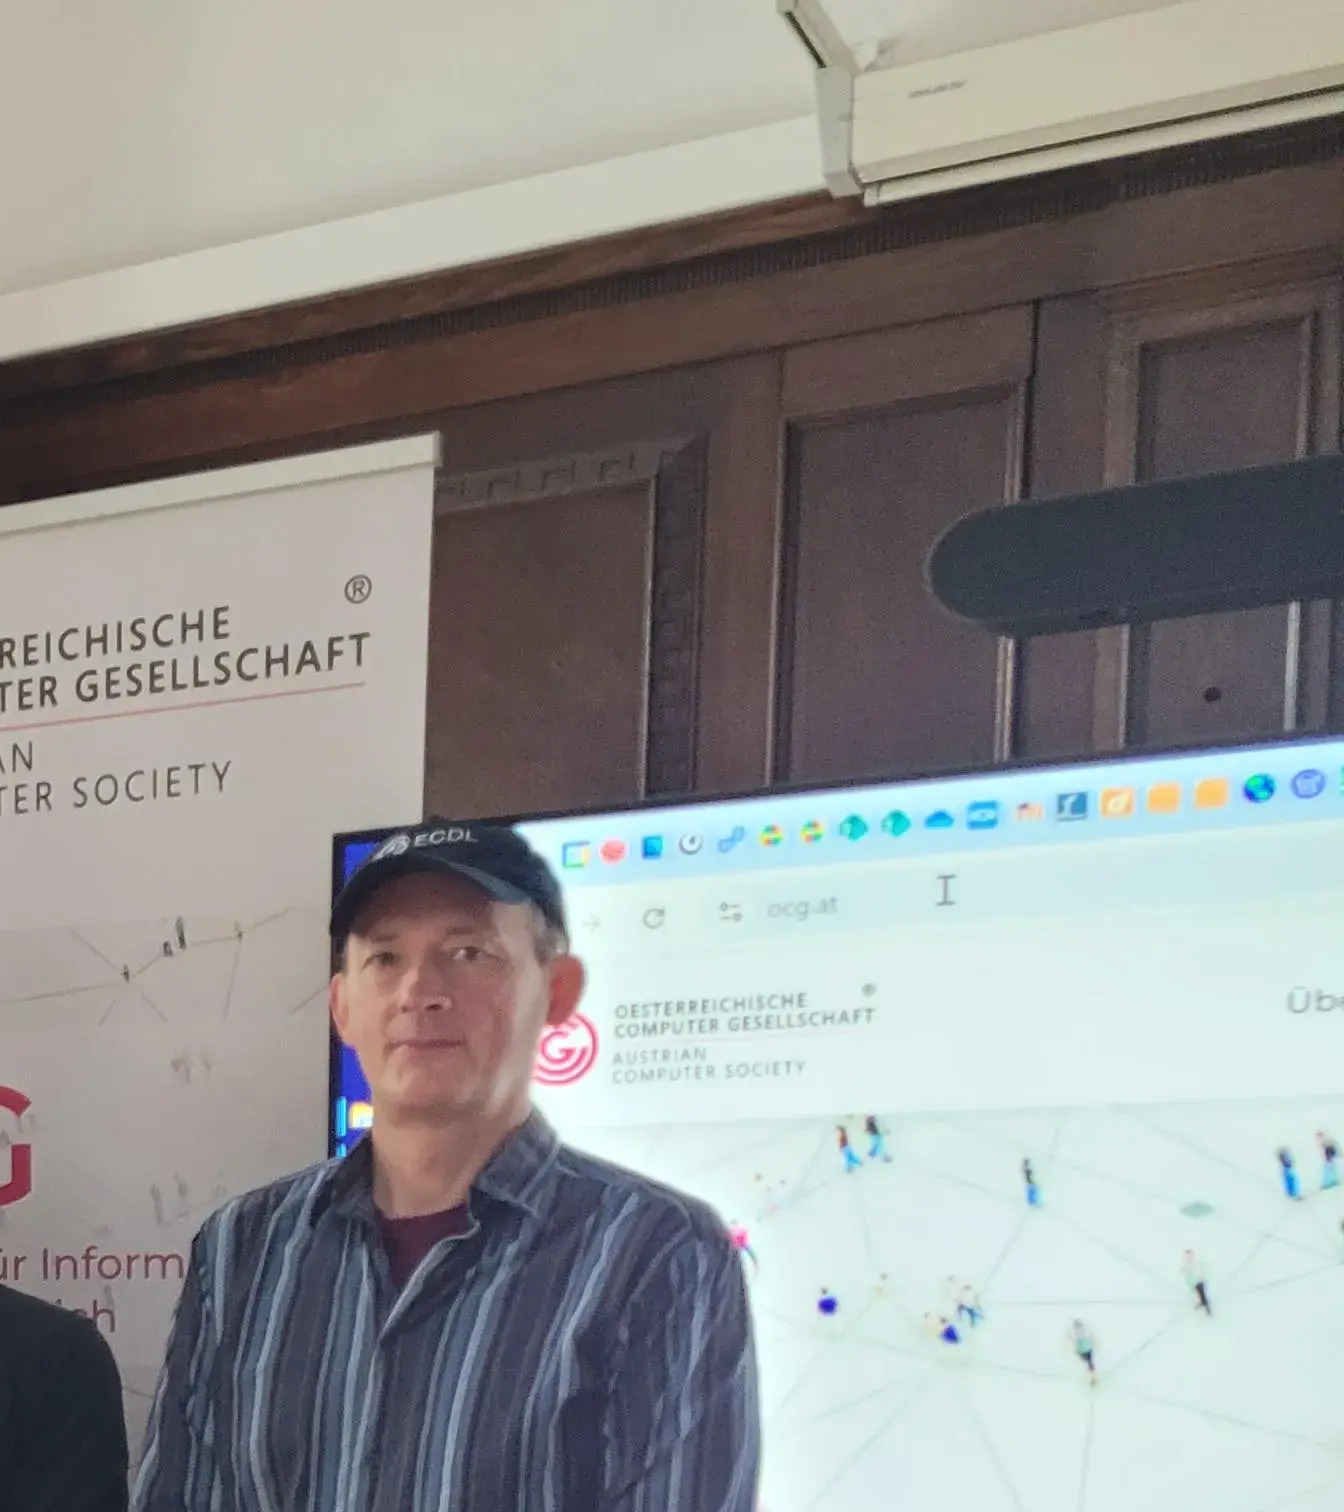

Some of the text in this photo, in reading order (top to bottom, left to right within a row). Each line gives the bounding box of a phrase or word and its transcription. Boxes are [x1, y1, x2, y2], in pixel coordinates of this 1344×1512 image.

[75, 633, 371, 702] GESELLSCHAFT
[73, 760, 232, 809] SOCIETY
[413, 828, 478, 848] ECDL
[767, 896, 838, 922] ocg.at
[614, 992, 808, 1020] OESTERREICHISCHE
[1287, 985, 1344, 1014] Üb
[614, 1007, 876, 1039] COMPUTER GESELLSCHAFT
[612, 1048, 707, 1065] AUSTRIAN
[611, 1060, 806, 1085] COMPUTER SOCIETY
[42, 1245, 184, 1281] Inform
